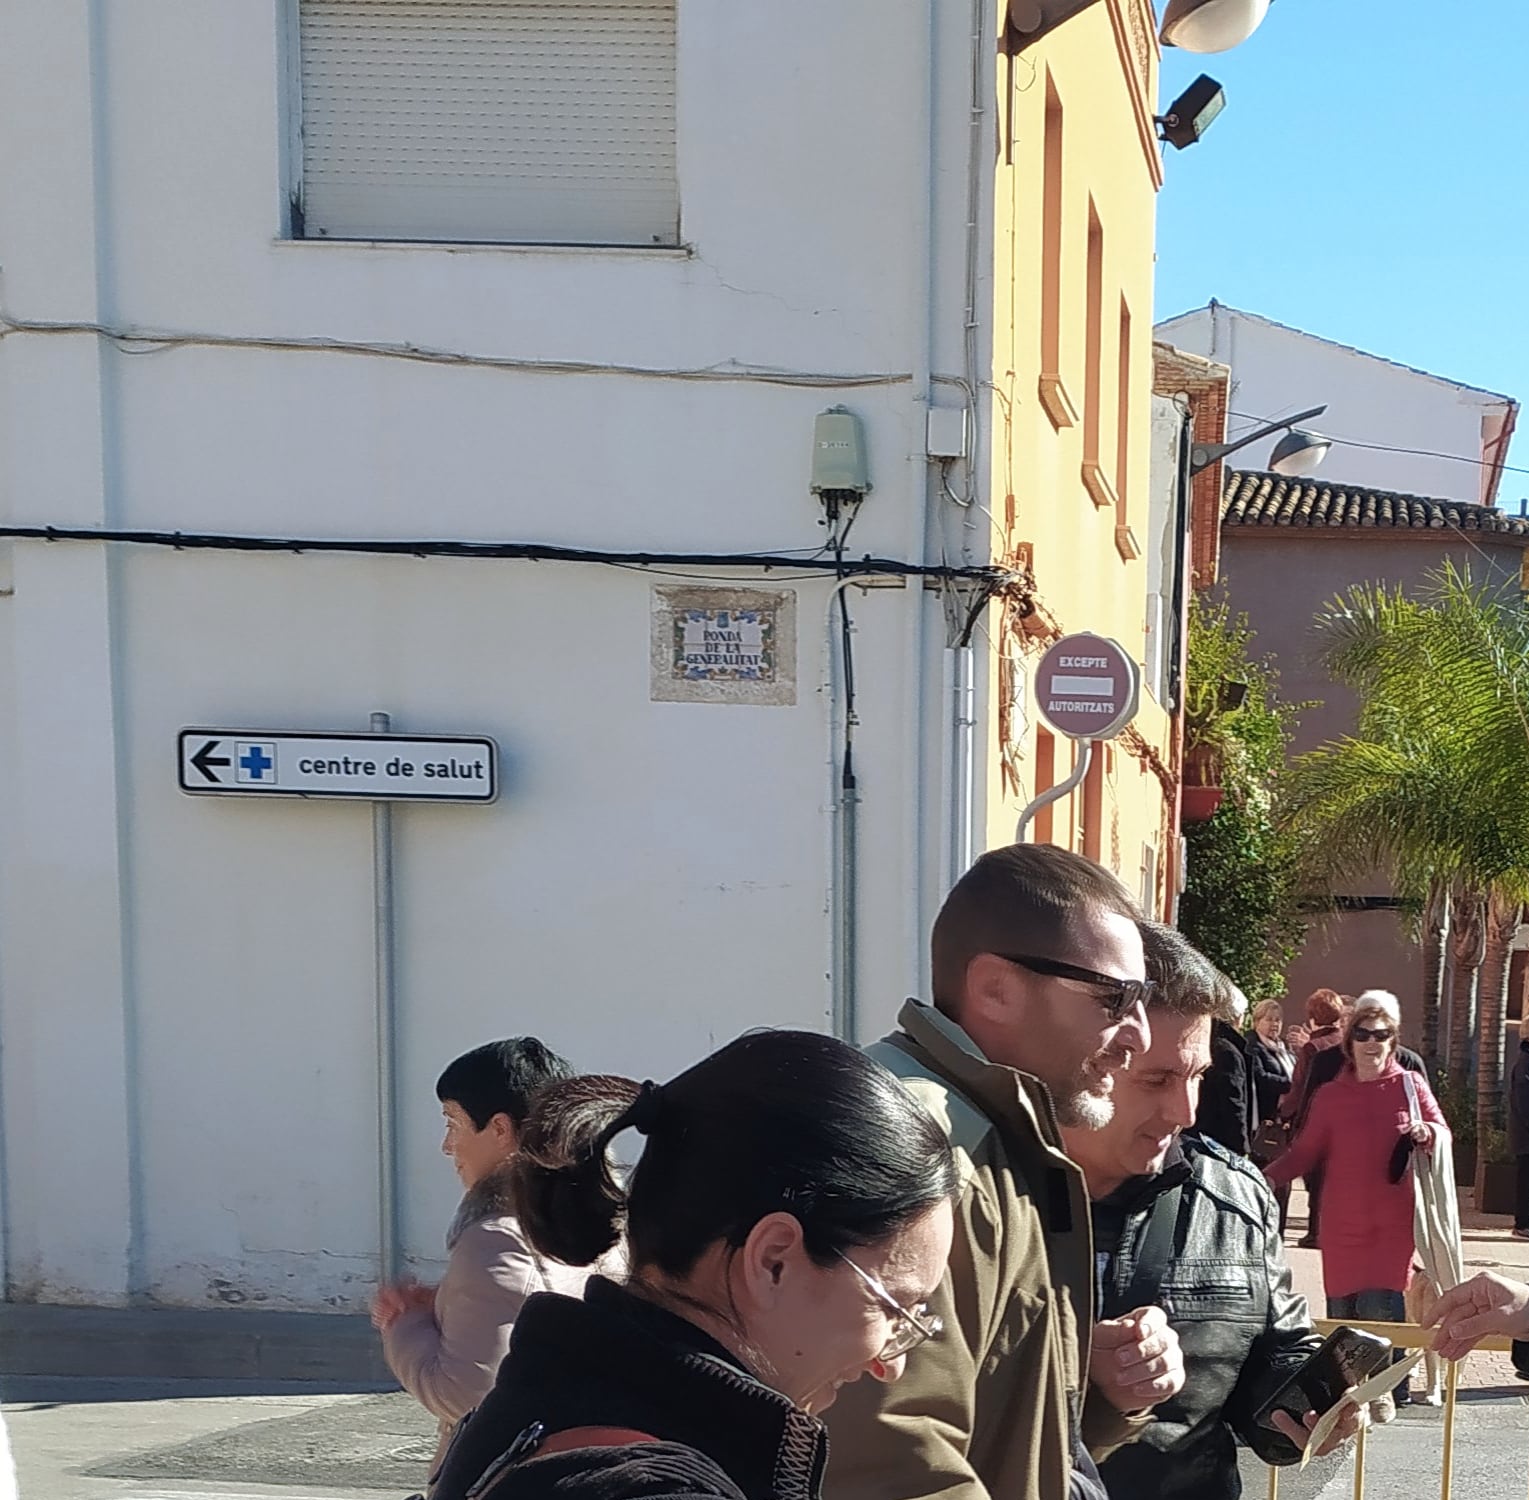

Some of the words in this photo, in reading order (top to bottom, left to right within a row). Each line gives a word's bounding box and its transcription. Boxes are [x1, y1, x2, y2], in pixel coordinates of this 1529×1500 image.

[705, 642, 720, 653] DE
[726, 642, 741, 653] LA
[686, 653, 760, 665] GENERALITAT
[1059, 656, 1108, 668] EXCEPTE
[1048, 701, 1114, 713] AUTORITZATS
[299, 756, 376, 776] centre
[385, 757, 414, 778] de
[423, 758, 484, 779] salut
